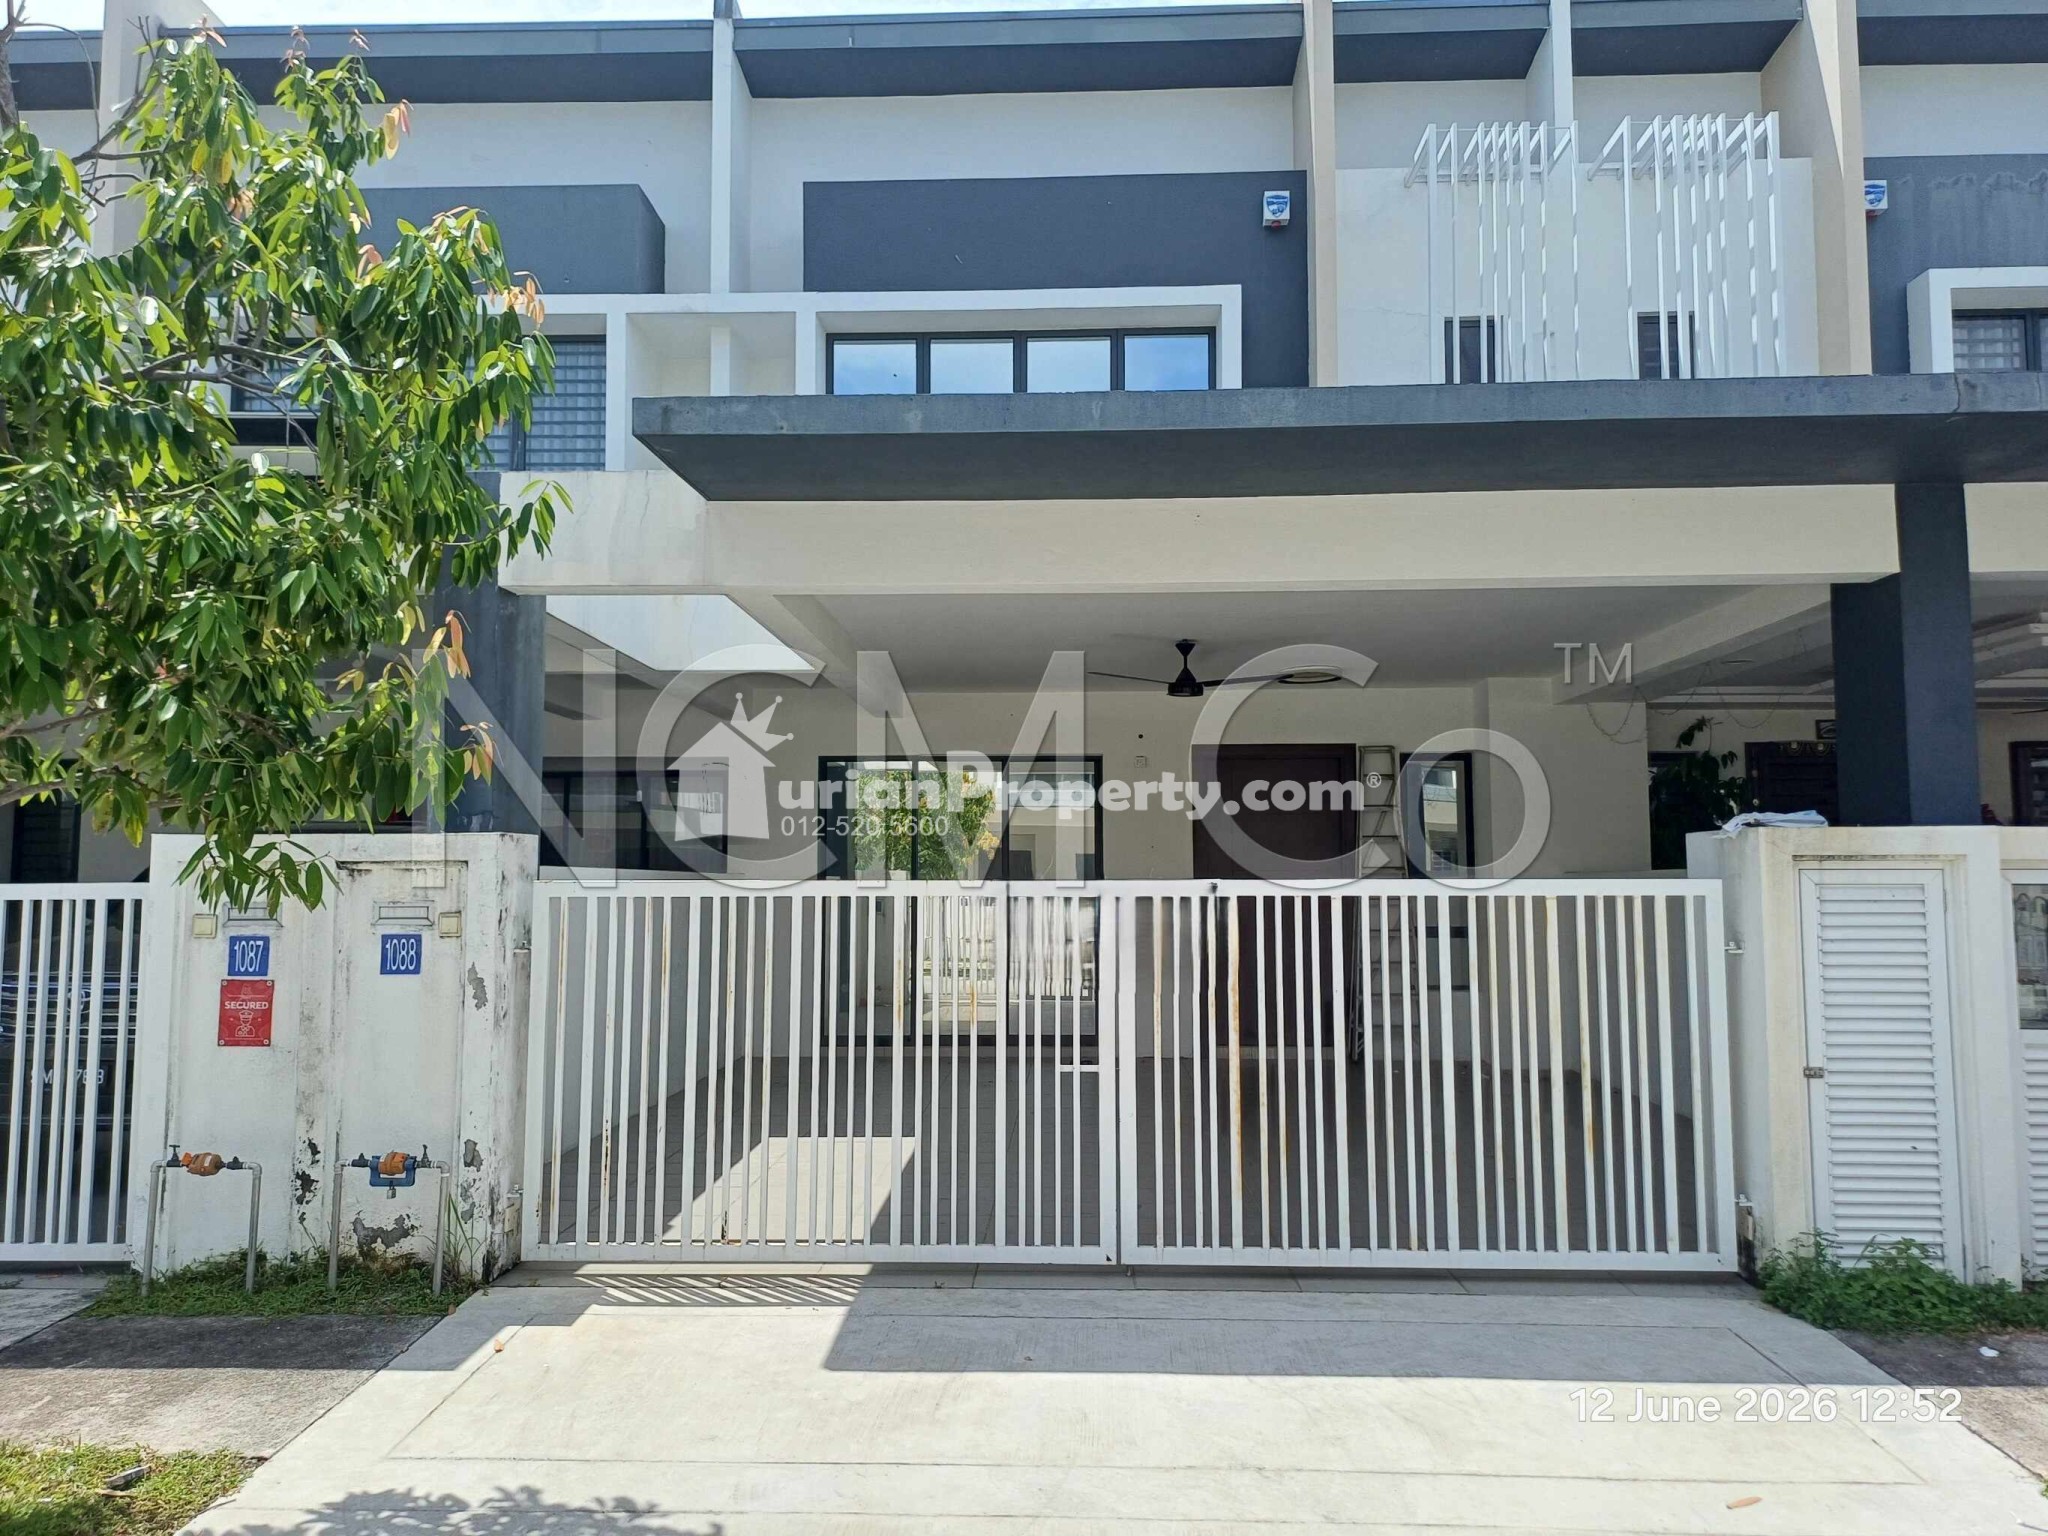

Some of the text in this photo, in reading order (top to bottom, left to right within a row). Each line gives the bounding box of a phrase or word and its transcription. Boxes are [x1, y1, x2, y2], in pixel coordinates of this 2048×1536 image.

[234, 940, 264, 972] 1087
[385, 938, 417, 970] 1088
[224, 1001, 269, 1009] SECURED
